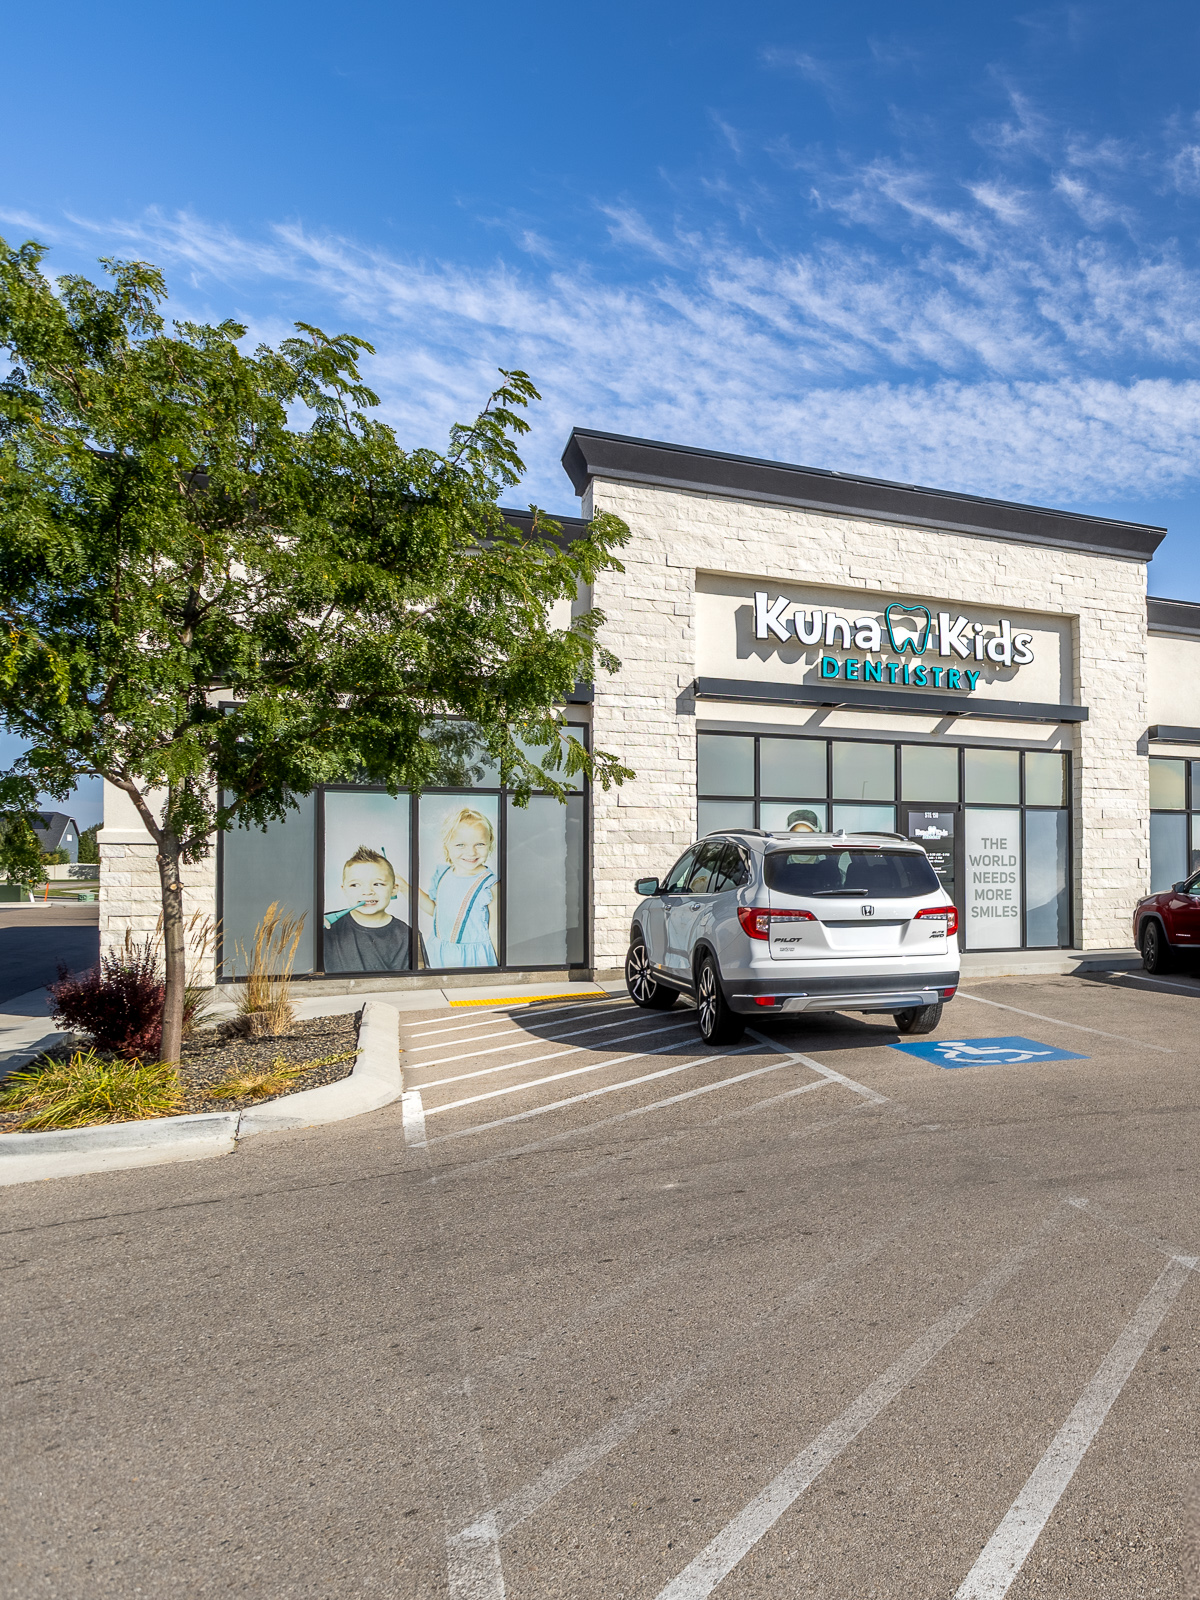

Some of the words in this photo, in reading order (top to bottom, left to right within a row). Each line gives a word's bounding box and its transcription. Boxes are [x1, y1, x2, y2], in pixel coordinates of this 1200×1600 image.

[753, 591, 881, 653] Kuna
[938, 611, 1035, 667] Kids
[821, 656, 981, 691] DENTISTRY
[981, 837, 1008, 850] THE
[968, 854, 1017, 867] WORLD
[973, 871, 1016, 884] NEEDS
[974, 888, 1012, 901] MORE
[971, 905, 1018, 918] SMILES
